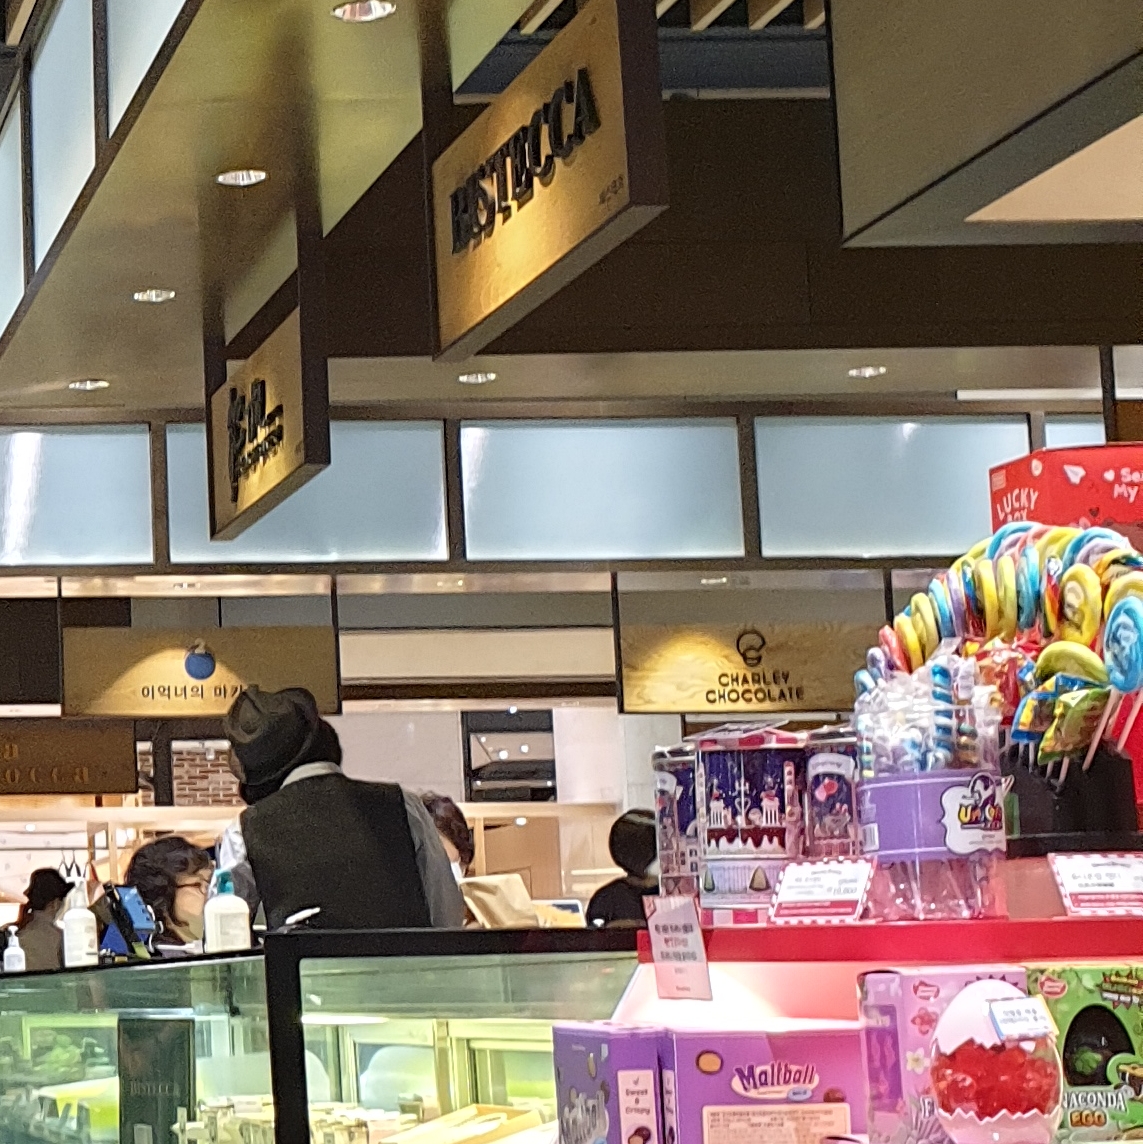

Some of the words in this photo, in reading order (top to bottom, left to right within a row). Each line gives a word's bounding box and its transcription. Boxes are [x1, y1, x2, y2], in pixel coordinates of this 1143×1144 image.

[1113, 483, 1139, 503] My
[996, 487, 1039, 521] LUCKY
[718, 669, 790, 687] CHARLEY
[705, 686, 805, 704] CHOCOLATE
[734, 1061, 815, 1092] Maltball
